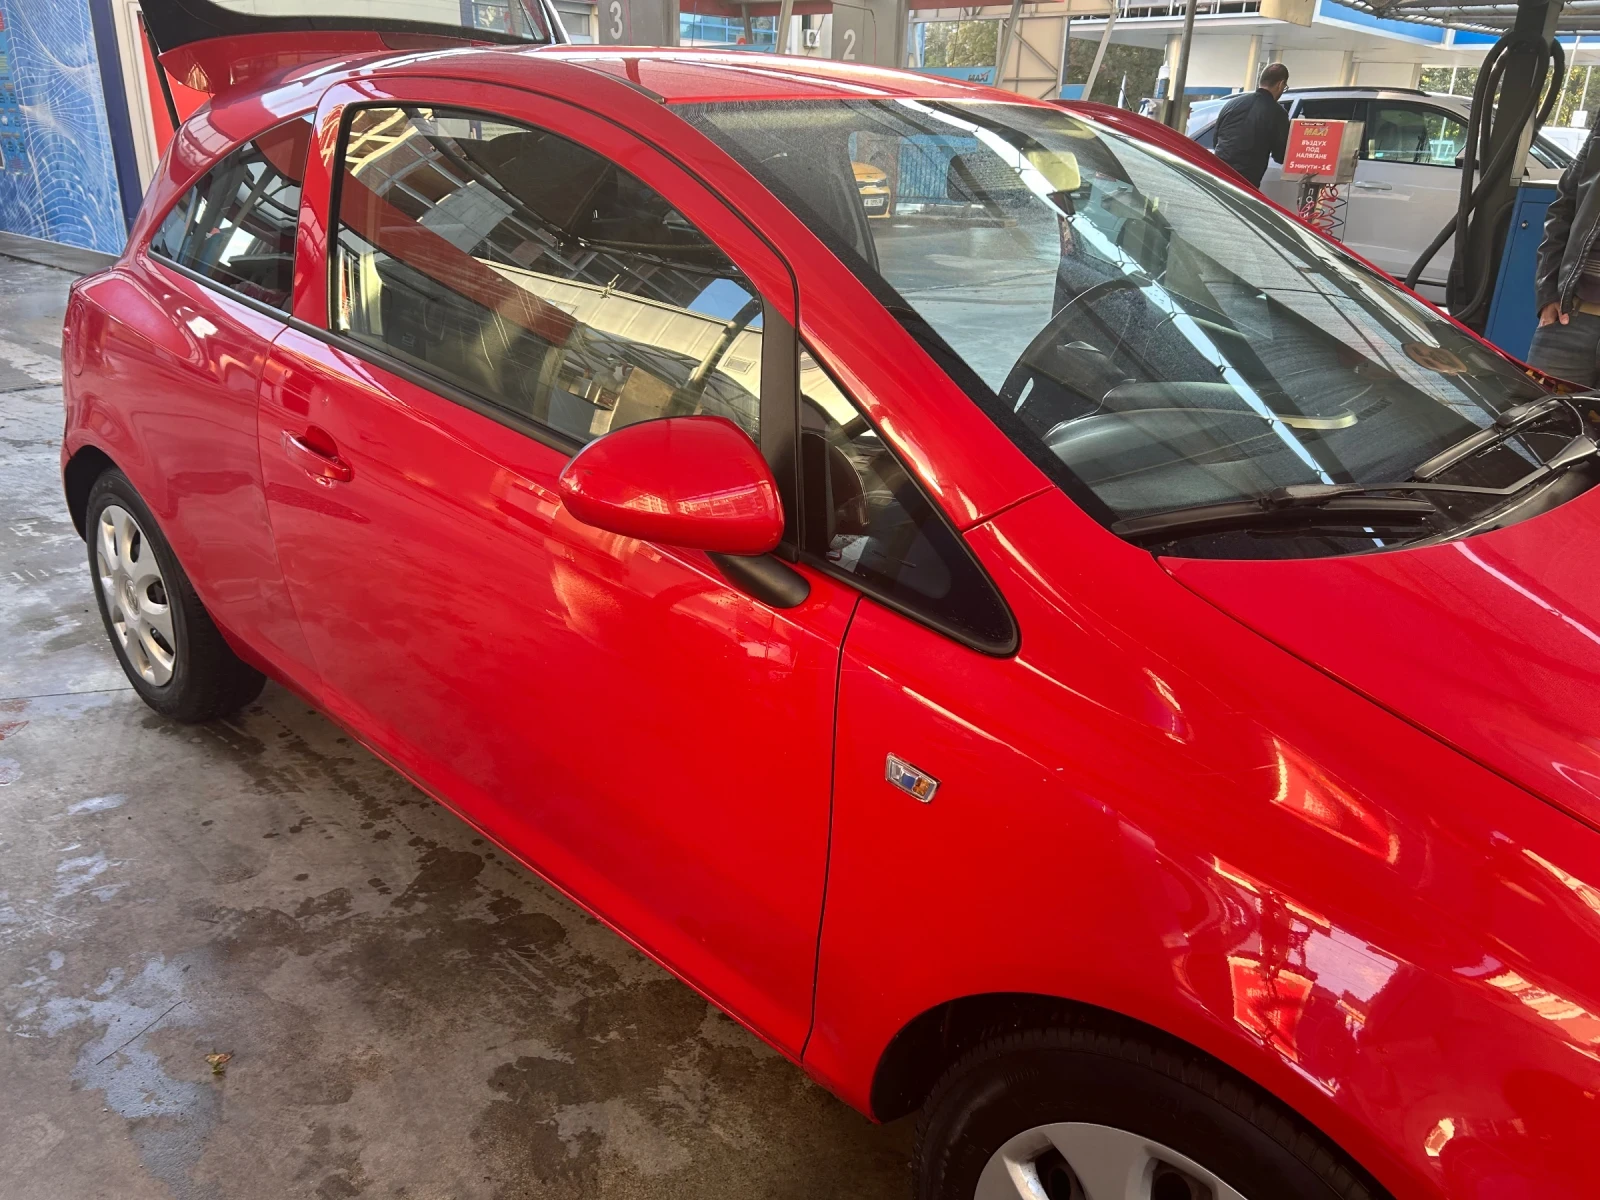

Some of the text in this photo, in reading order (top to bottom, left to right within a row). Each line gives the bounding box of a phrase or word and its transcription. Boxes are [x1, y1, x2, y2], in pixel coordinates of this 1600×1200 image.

[610, 1, 622, 39] 3
[843, 29, 855, 60] 2
[1289, 161, 1294, 169] 5
